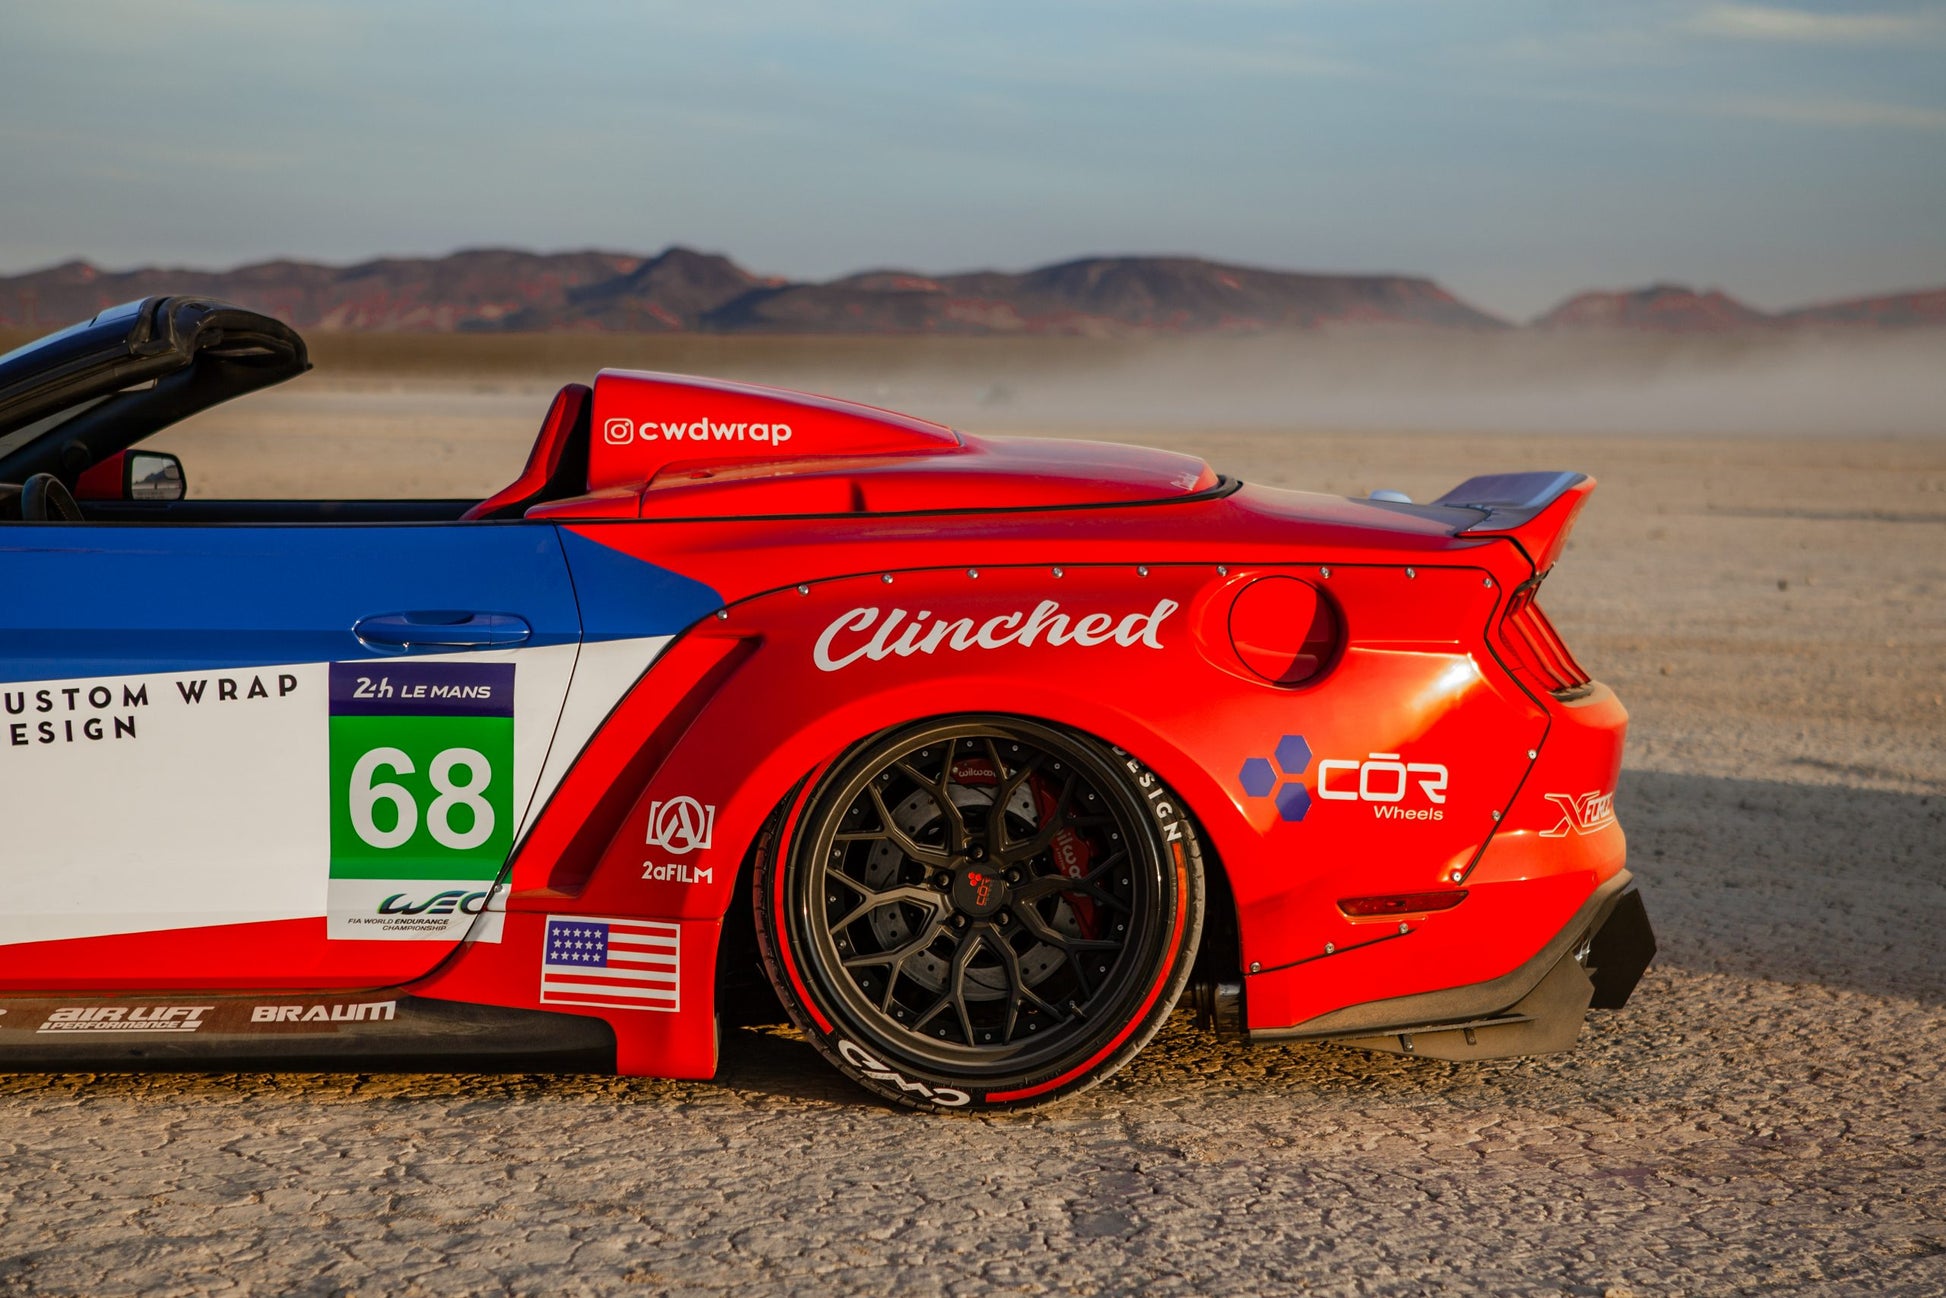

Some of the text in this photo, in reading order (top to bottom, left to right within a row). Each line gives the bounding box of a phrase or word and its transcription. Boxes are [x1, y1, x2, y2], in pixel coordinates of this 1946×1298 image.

[638, 416, 792, 447] cwdwrap
[813, 599, 1180, 672] Clinched
[176, 674, 298, 705] WRAP
[400, 685, 428, 698] LE
[430, 685, 492, 699] MANS
[349, 747, 496, 850] 68
[1373, 805, 1444, 821] Wheels
[641, 860, 714, 885] 2aFILM
[377, 890, 488, 914] WEC
[128, 1006, 215, 1021] LIFT
[250, 1001, 397, 1023] BRAUM
